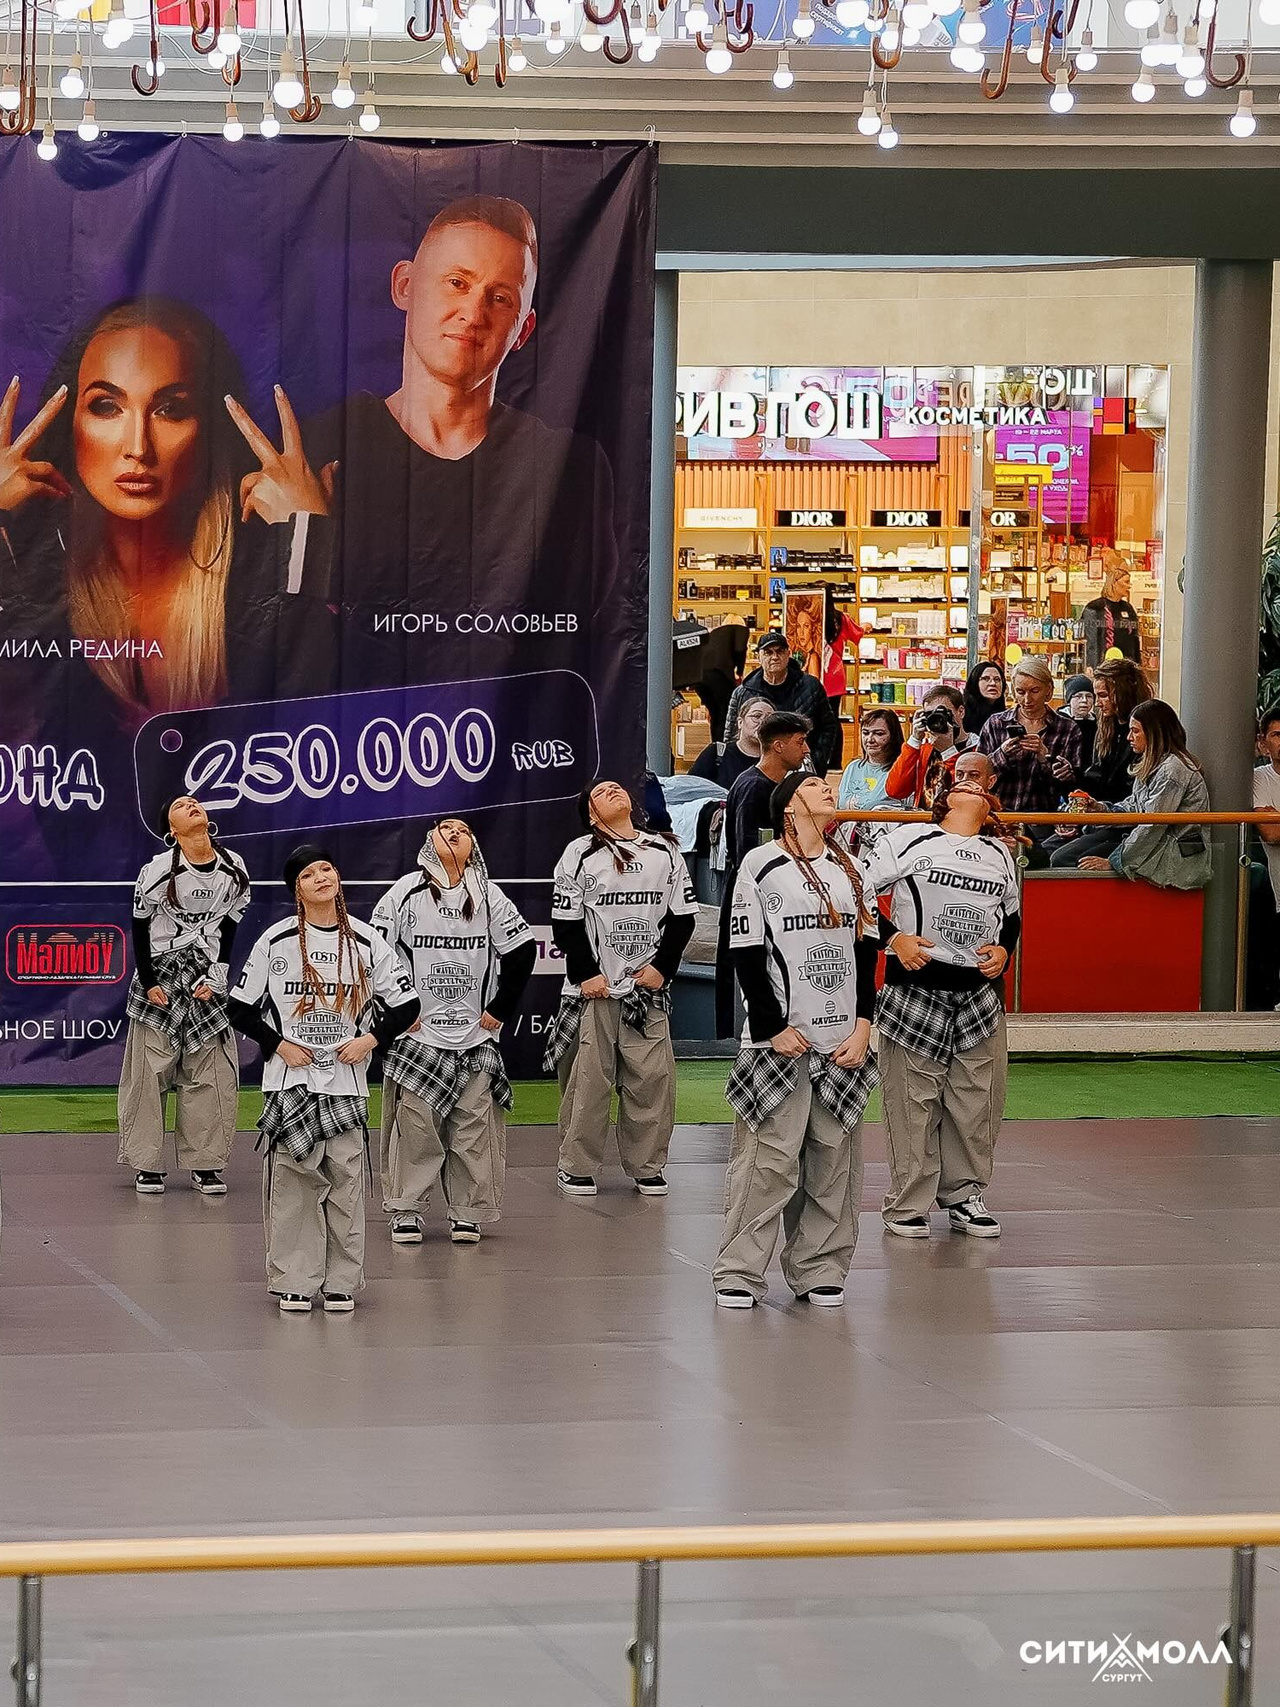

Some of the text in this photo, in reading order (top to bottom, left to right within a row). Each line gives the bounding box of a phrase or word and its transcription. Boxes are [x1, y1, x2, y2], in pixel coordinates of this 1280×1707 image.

[676, 388, 758, 439] ИВ
[768, 385, 883, 440] ГОШ
[905, 404, 1048, 426] КОСМЕТИКА
[790, 511, 834, 527] DIOR
[886, 511, 929, 527] DIOR
[990, 511, 1017, 527] OR
[374, 613, 579, 634] ИГОРЬ СОЛОВЬЕВ
[69, 639, 164, 661] РЕДИНА
[184, 707, 575, 810] 250.000 RUB
[927, 870, 1005, 897] DUCKDIVE
[595, 892, 663, 906] DUCKDIVE
[413, 935, 486, 949] DUCKDIVE
[16, 932, 114, 974] Малибу
[62, 1020, 122, 1040] ШОУ
